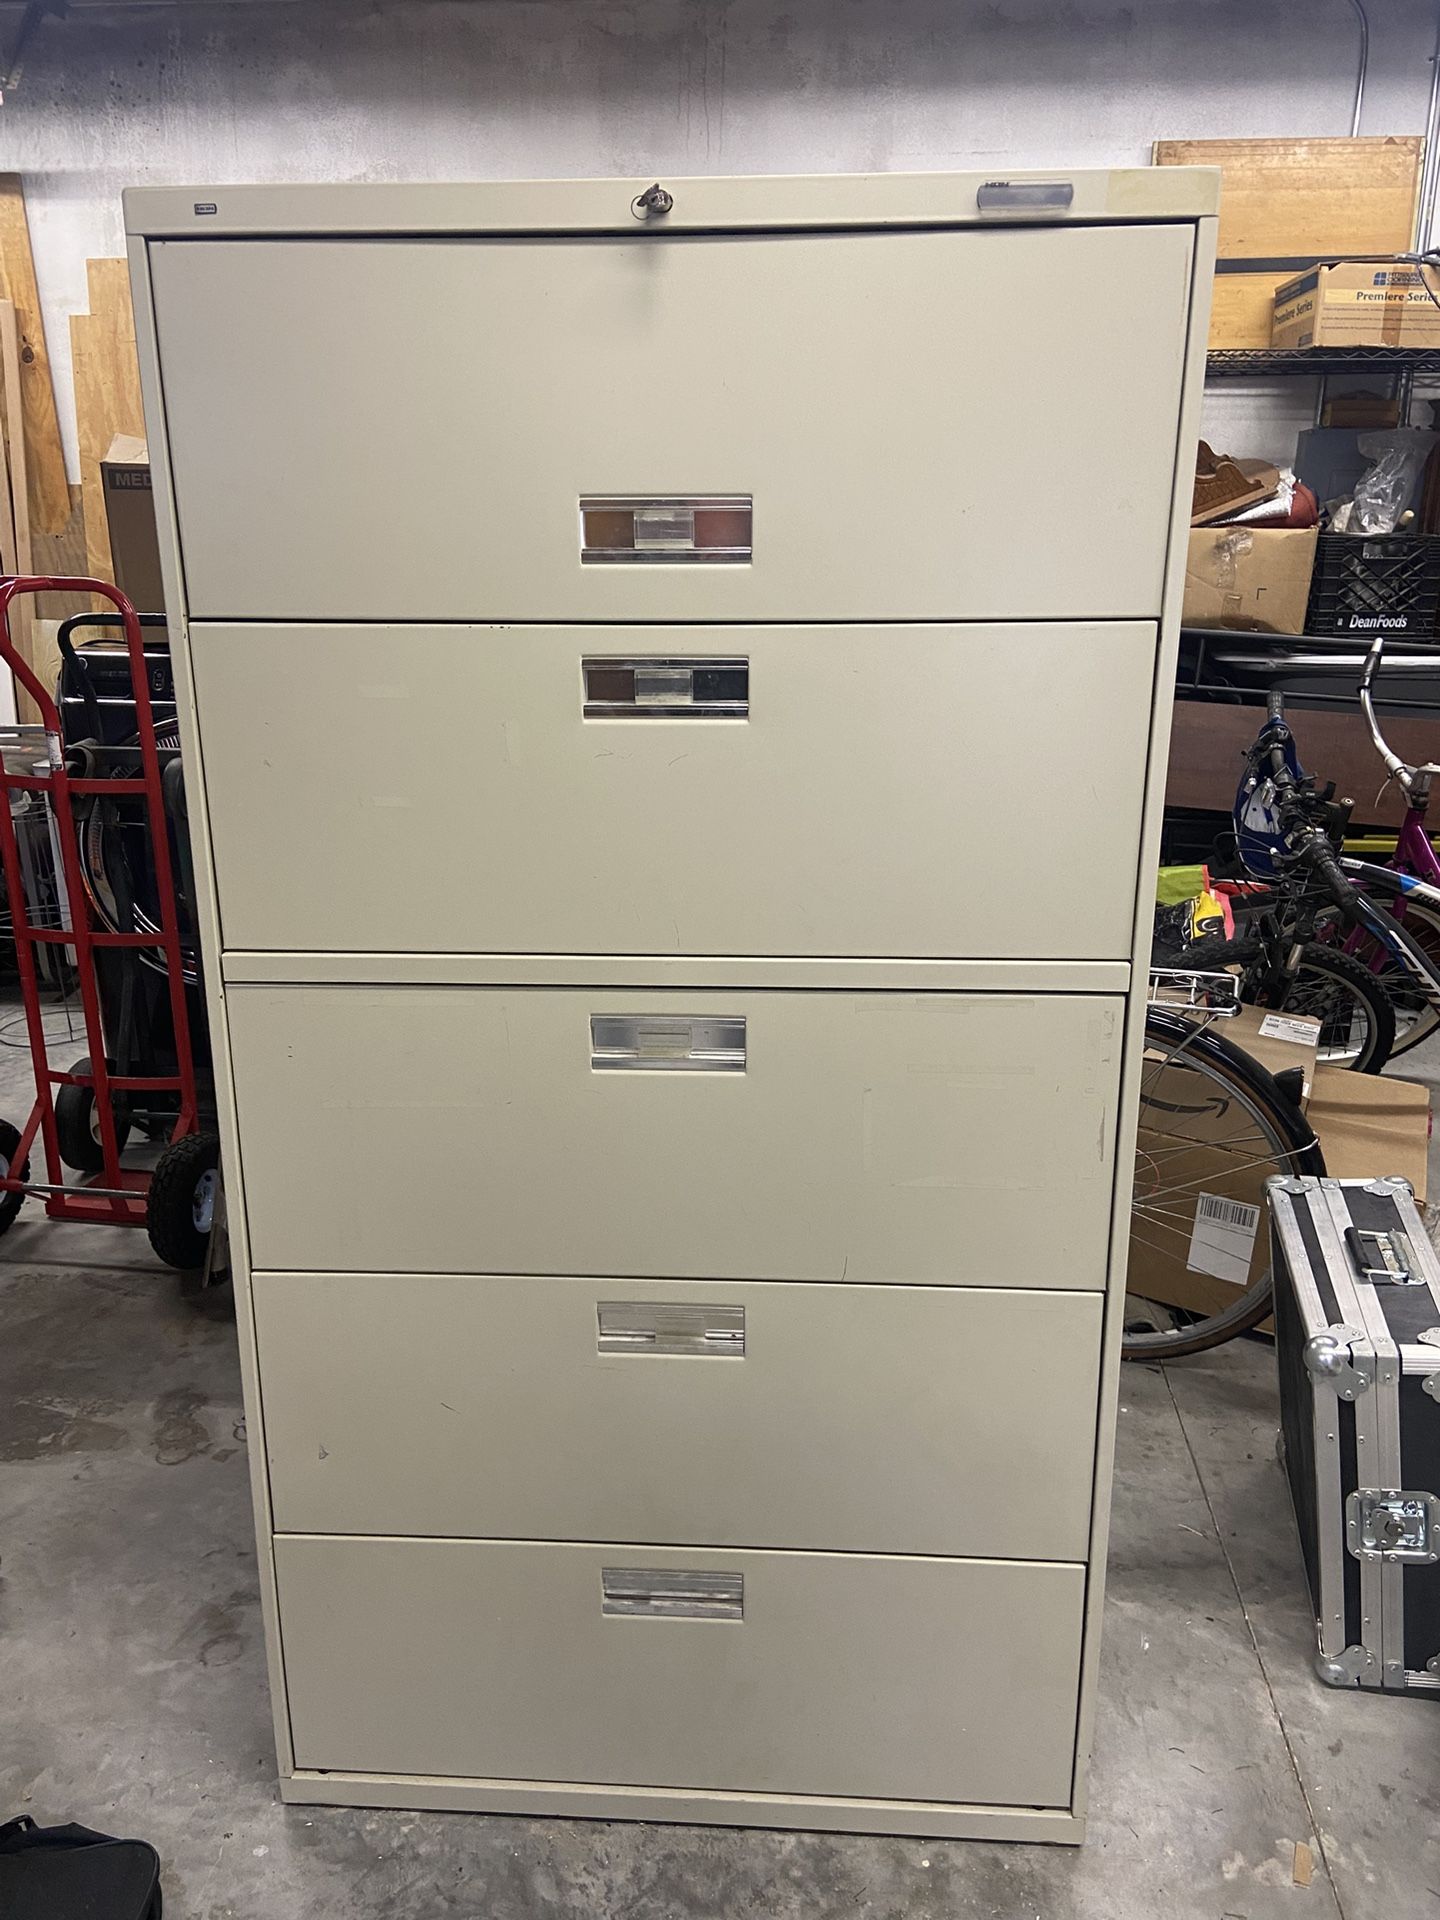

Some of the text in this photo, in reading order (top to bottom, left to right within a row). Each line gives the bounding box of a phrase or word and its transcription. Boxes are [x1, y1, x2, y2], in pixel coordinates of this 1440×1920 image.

[1356, 291, 1405, 301] Premiere
[1296, 300, 1313, 316] Series
[1349, 614, 1408, 628] DeanFoods
